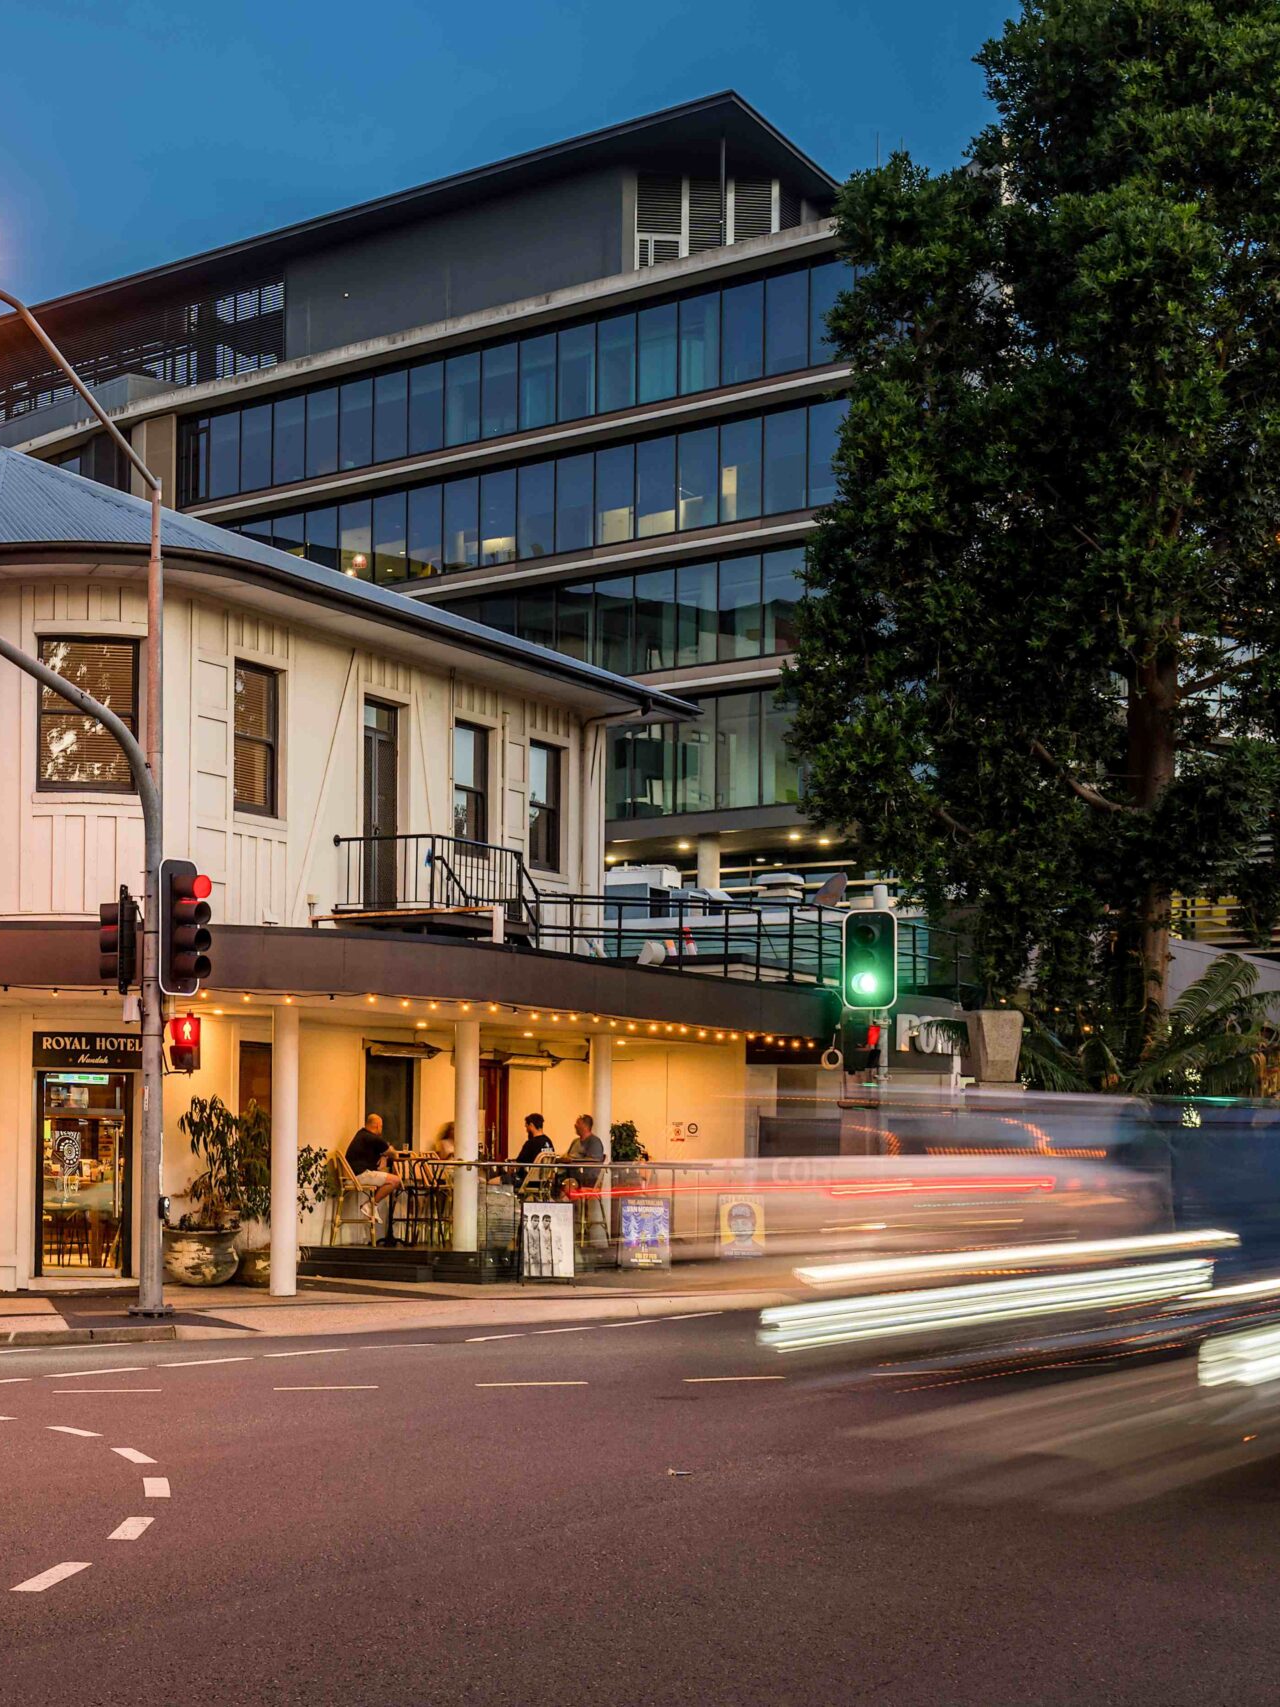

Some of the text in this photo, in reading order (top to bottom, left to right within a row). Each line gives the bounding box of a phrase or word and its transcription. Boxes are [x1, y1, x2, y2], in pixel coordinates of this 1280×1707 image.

[42, 1036, 143, 1052] ROYAL HOTEL
[77, 1053, 108, 1064] Nundah
